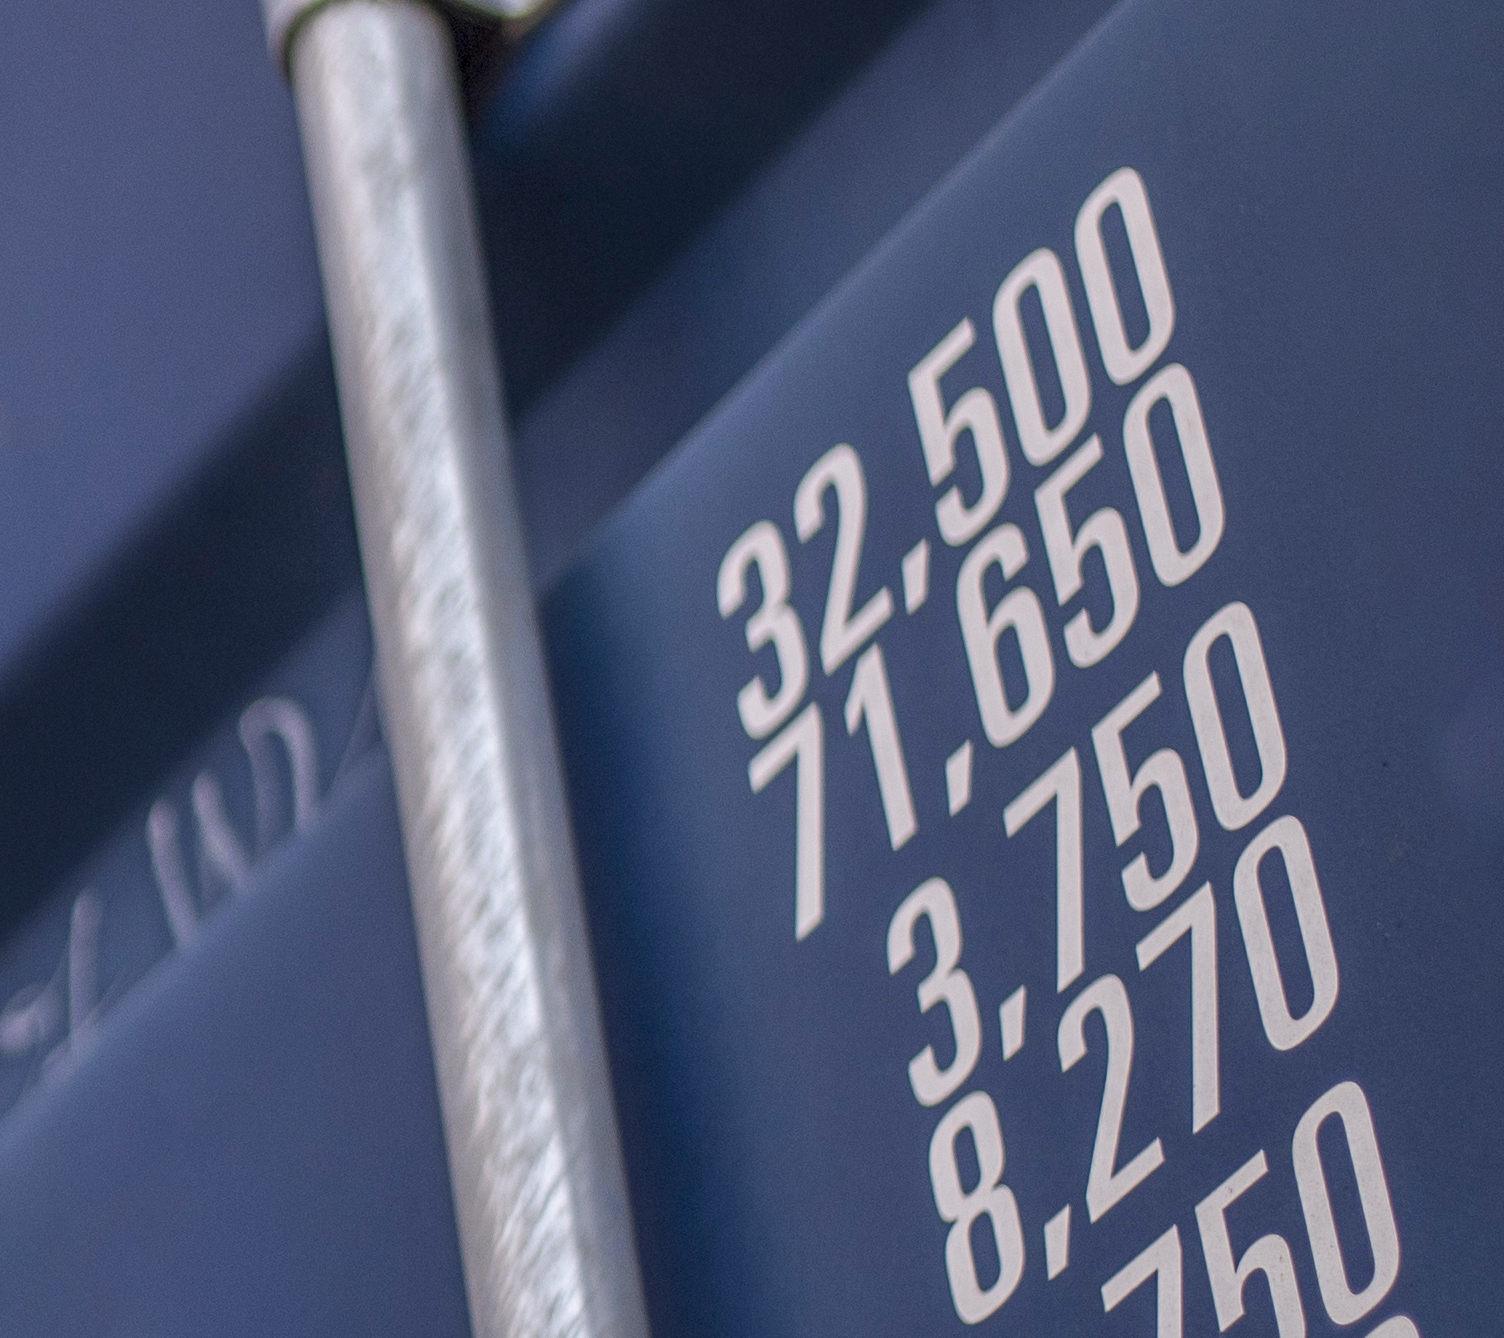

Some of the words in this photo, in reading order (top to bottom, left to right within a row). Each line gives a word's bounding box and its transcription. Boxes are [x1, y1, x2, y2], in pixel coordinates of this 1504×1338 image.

[716, 166, 1177, 740] 32,500
[748, 362, 1227, 941] 71,650
[886, 600, 1289, 1108] 3,750
[928, 813, 1341, 1326] 8,270
